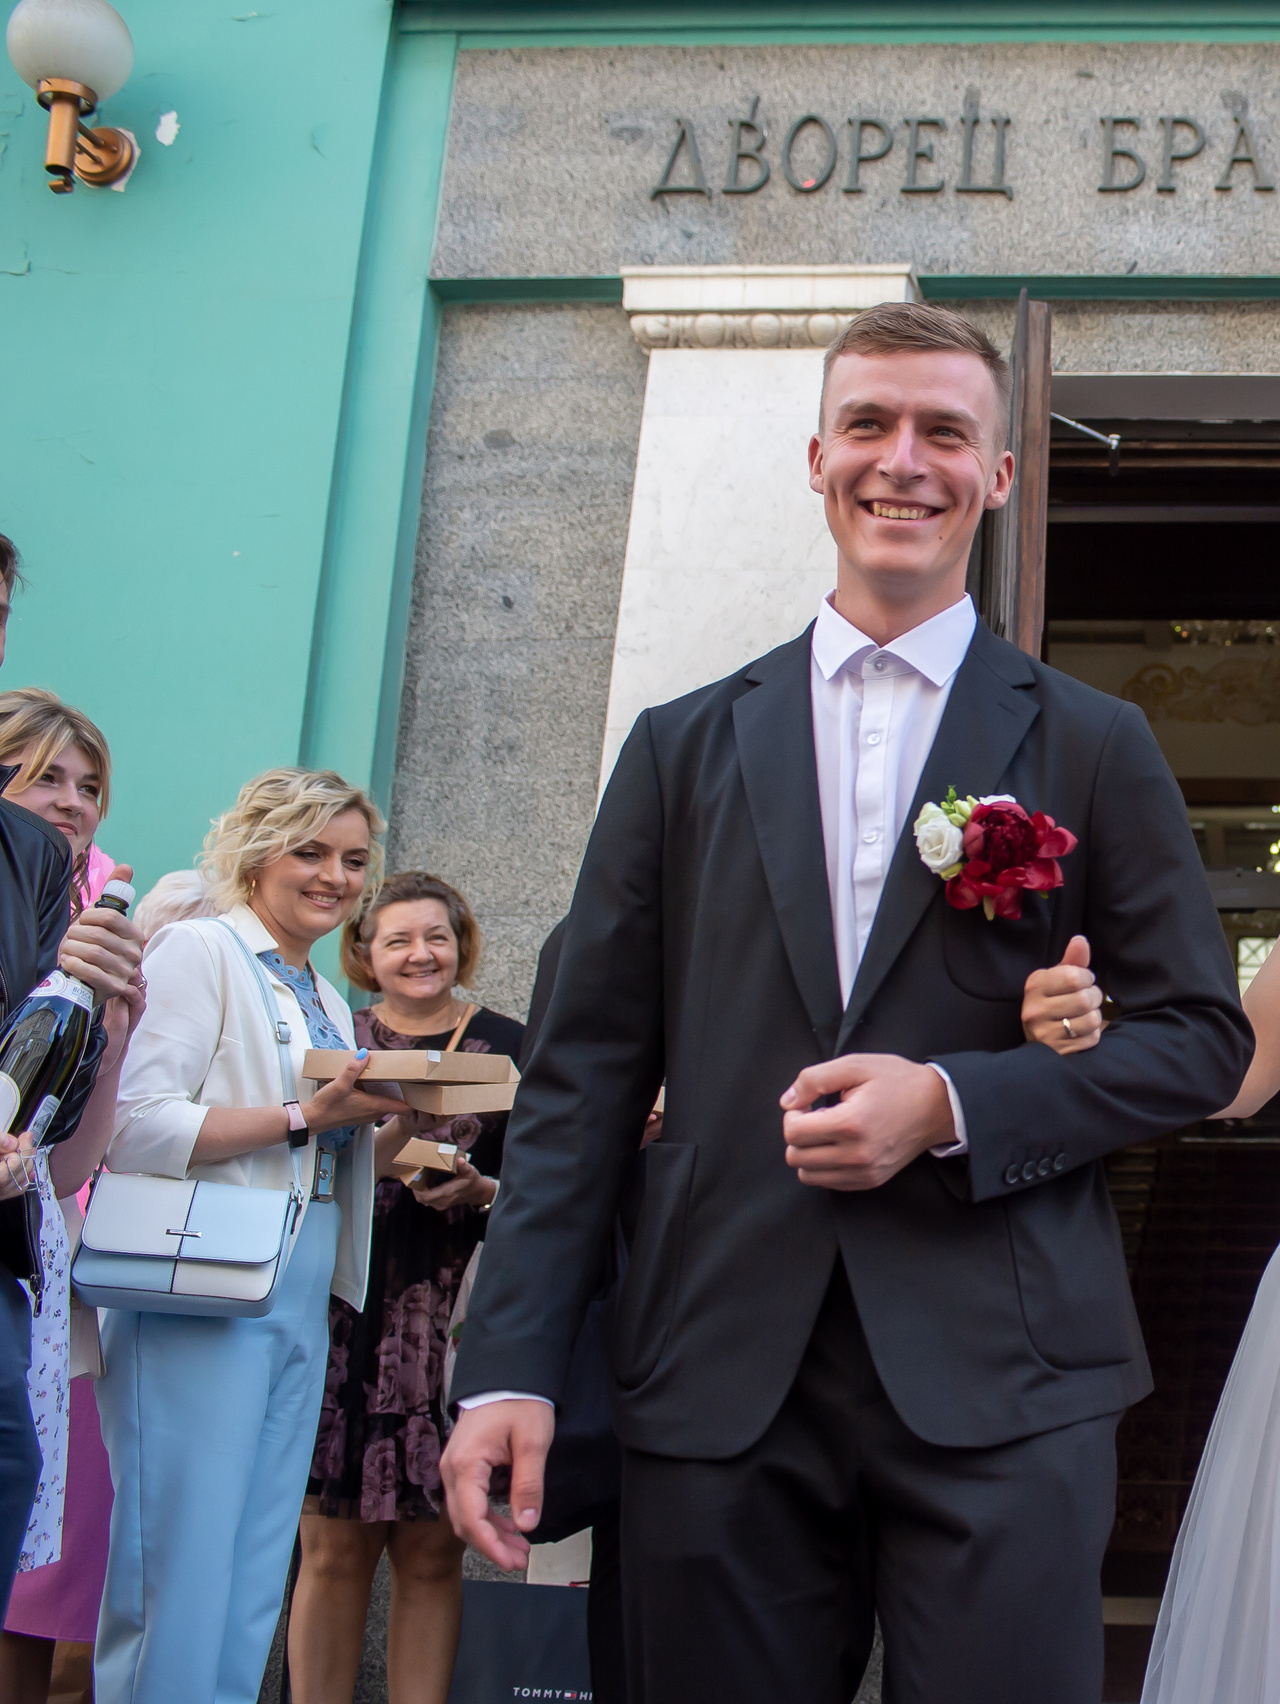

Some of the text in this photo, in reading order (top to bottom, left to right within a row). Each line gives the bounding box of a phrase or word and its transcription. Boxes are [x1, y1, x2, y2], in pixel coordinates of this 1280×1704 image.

[651, 114, 1013, 201] ДВОРЕЦ
[513, 1686, 593, 1701] TOMMY HI
